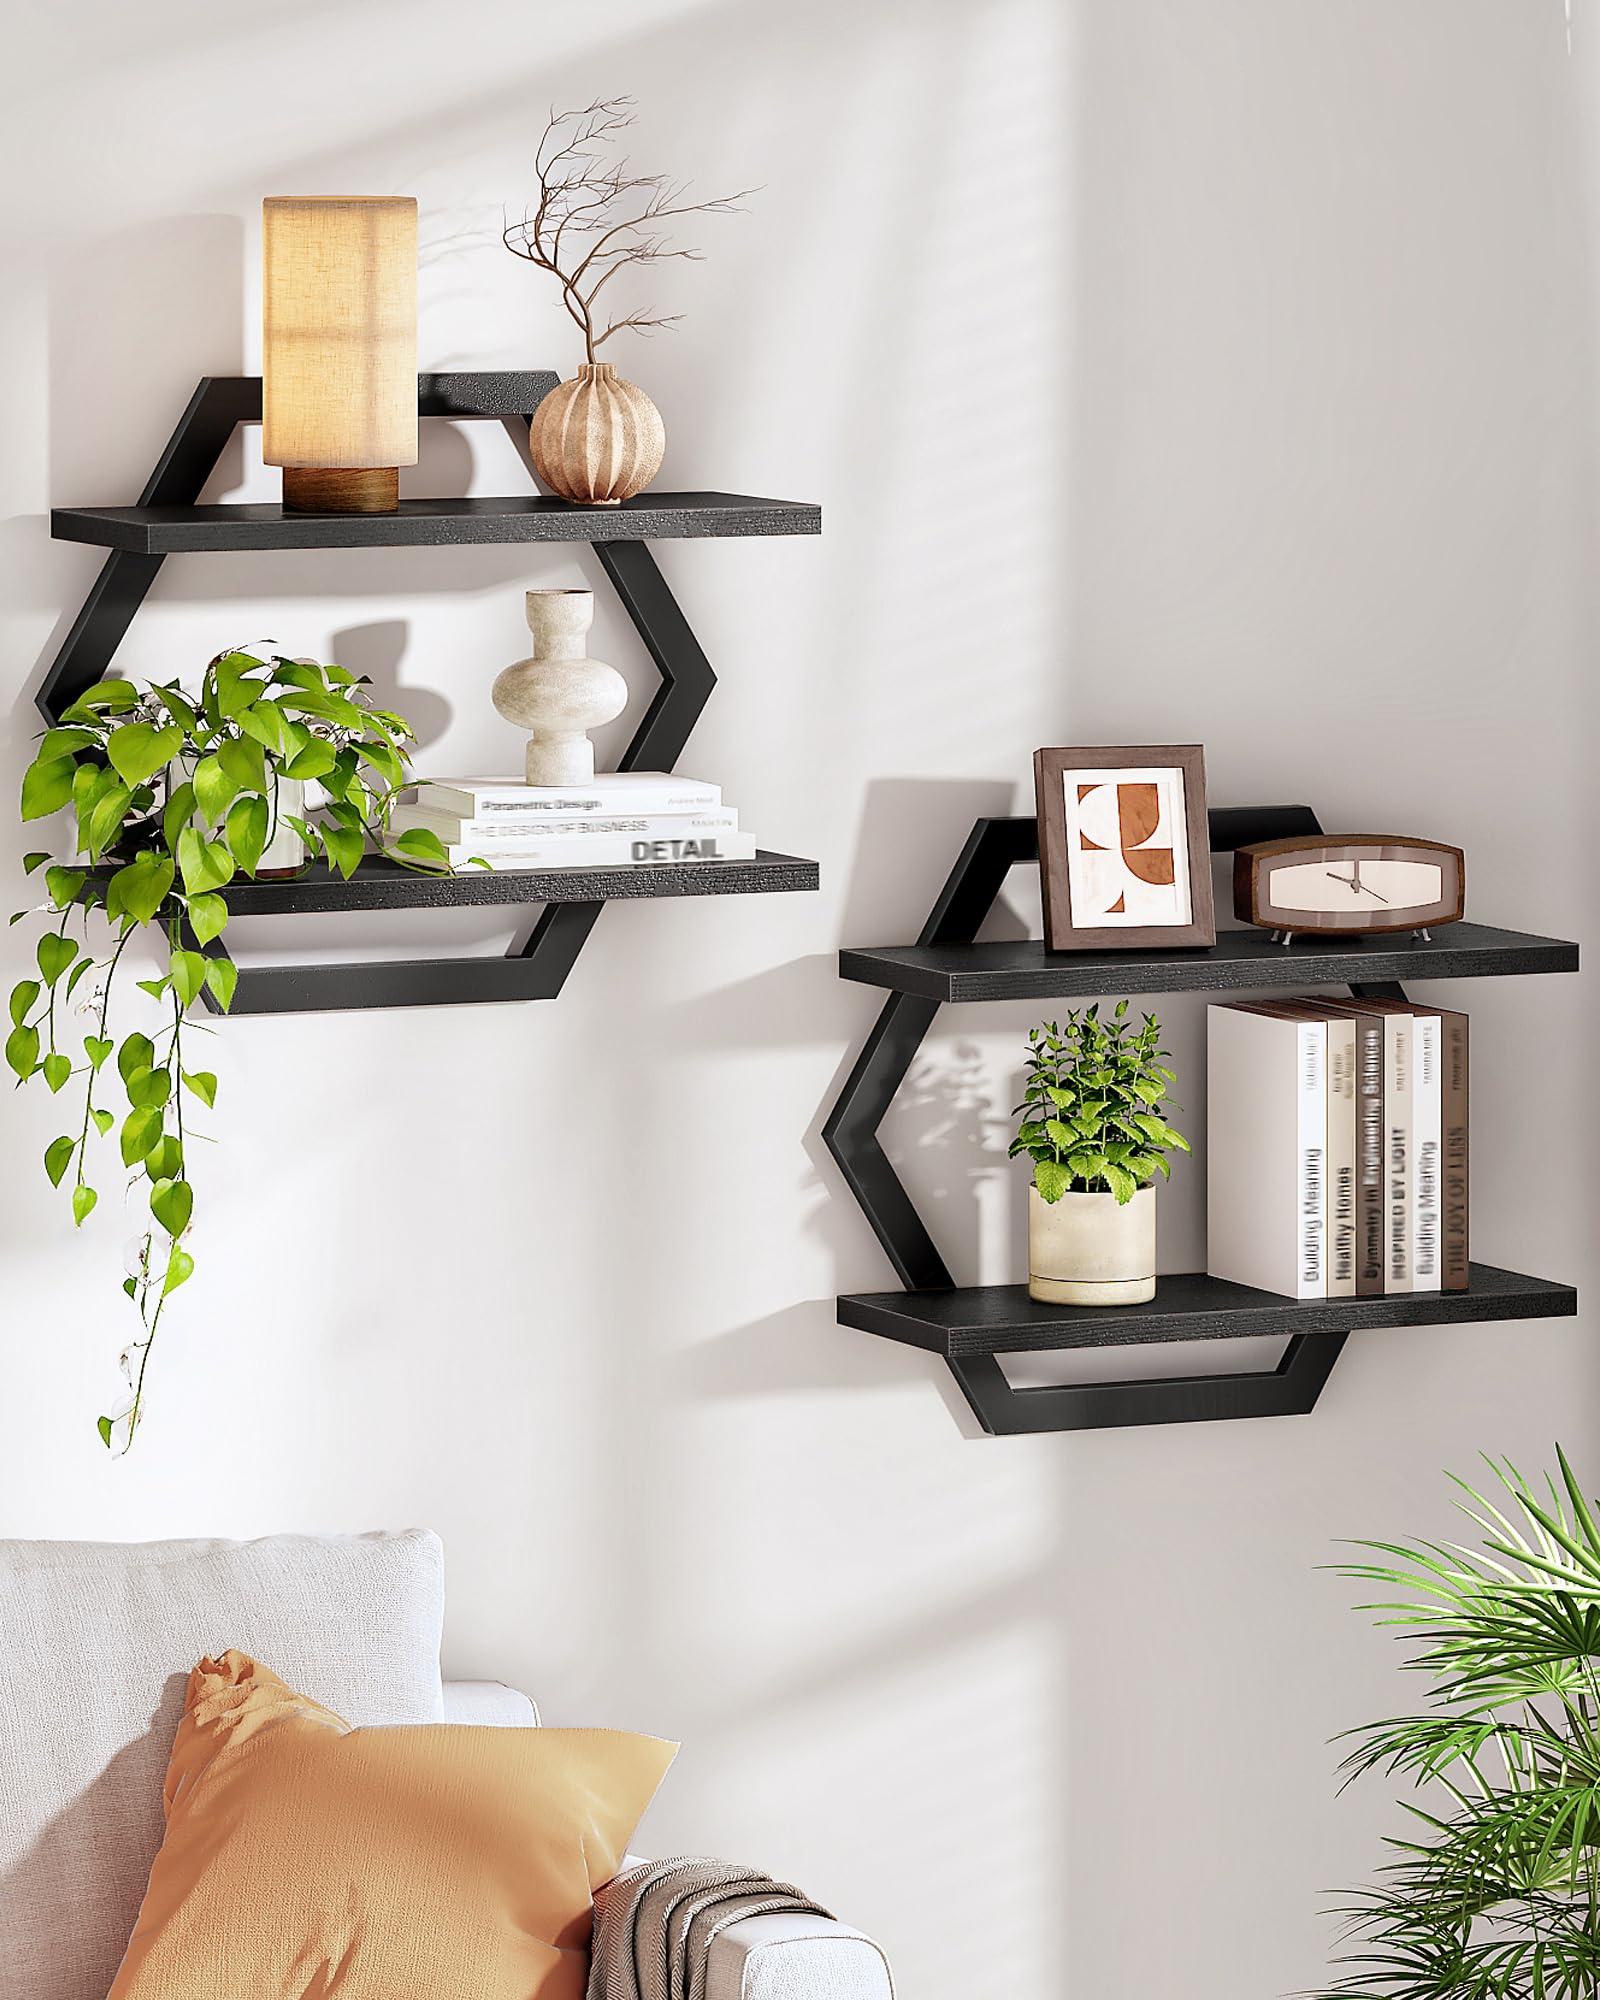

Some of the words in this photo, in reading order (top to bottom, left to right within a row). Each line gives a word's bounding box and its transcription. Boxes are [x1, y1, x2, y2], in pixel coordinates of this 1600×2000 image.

[481, 800, 553, 811] Parametric
[554, 798, 603, 811] Design
[577, 820, 649, 833] BUSINESS
[631, 838, 725, 861] DETAIL
[1361, 1029, 1380, 1095] Sciences
[1361, 1098, 1382, 1186] Engineering
[1391, 1127, 1406, 1174] LIGHT
[1447, 1127, 1465, 1169] LESS
[1303, 1148, 1323, 1215] Meaning
[1335, 1167, 1352, 1219] Homes
[1391, 1179, 1405, 1200] BY
[1417, 1141, 1438, 1209] Meaning
[1447, 1174, 1465, 1198] OF
[1361, 1207, 1381, 1279] Symmetry
[1391, 1205, 1406, 1280] INSPIRED
[1415, 1212, 1438, 1275] Building
[1447, 1202, 1465, 1235] JOY
[1303, 1219, 1323, 1282] Building
[1335, 1224, 1355, 1281] Healthy
[1447, 1239, 1465, 1275] THE
